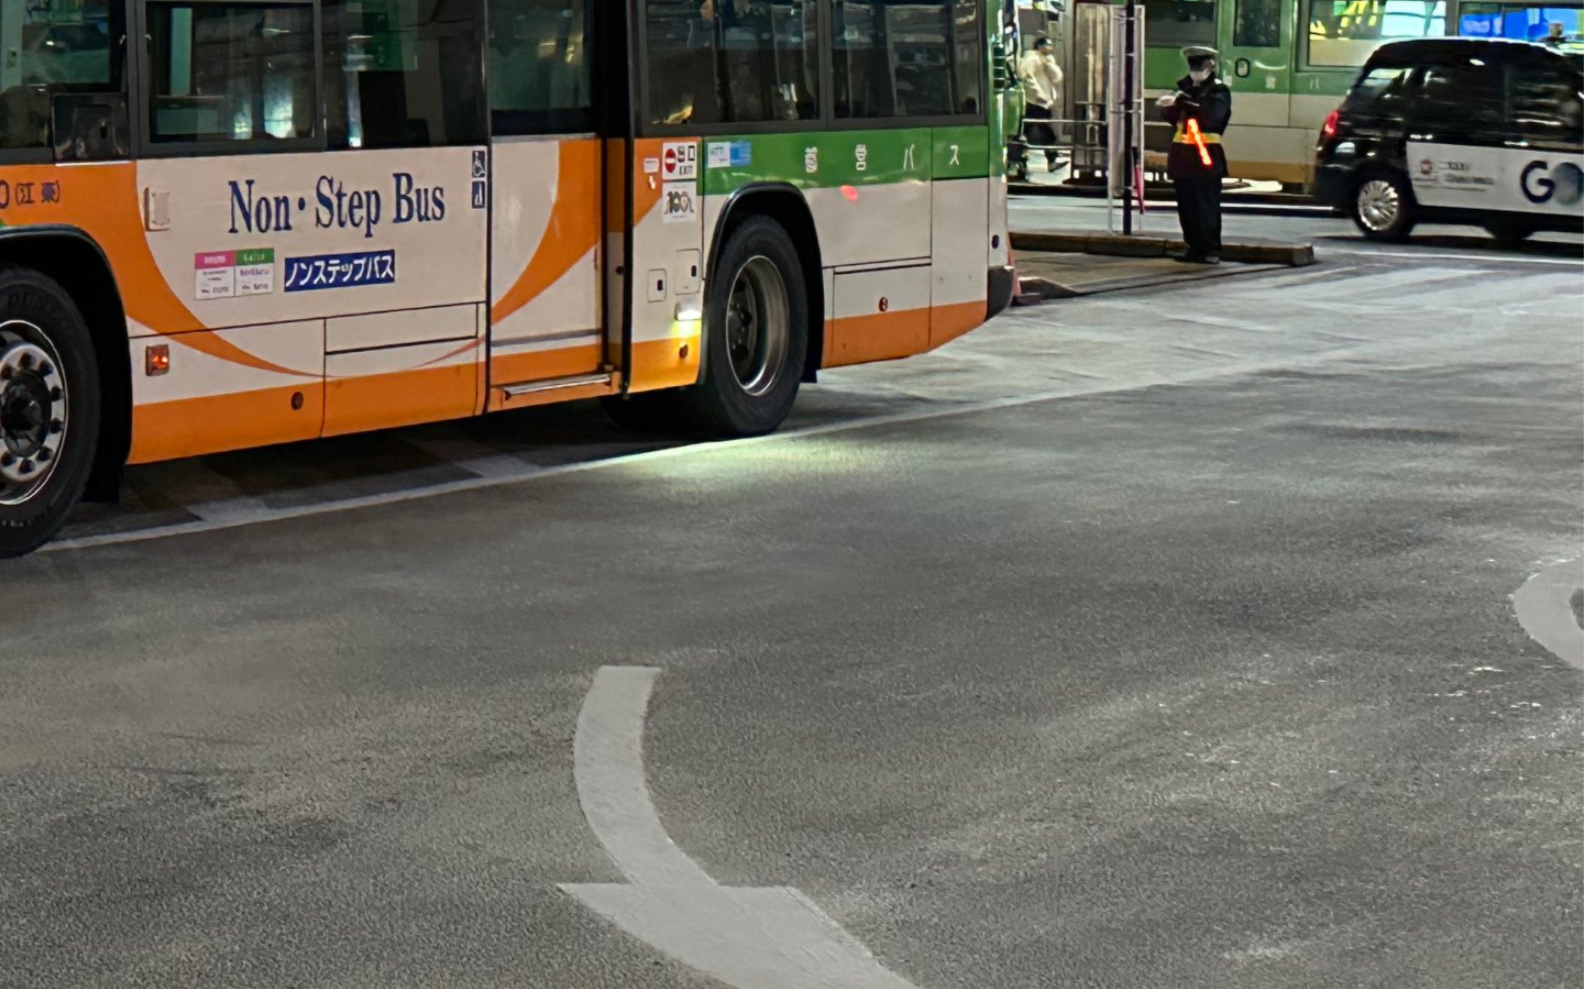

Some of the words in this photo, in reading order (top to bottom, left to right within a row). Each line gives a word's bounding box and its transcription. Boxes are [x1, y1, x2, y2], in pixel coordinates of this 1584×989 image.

[392, 172, 446, 223] Bus
[285, 255, 394, 287] ノンステップバス
